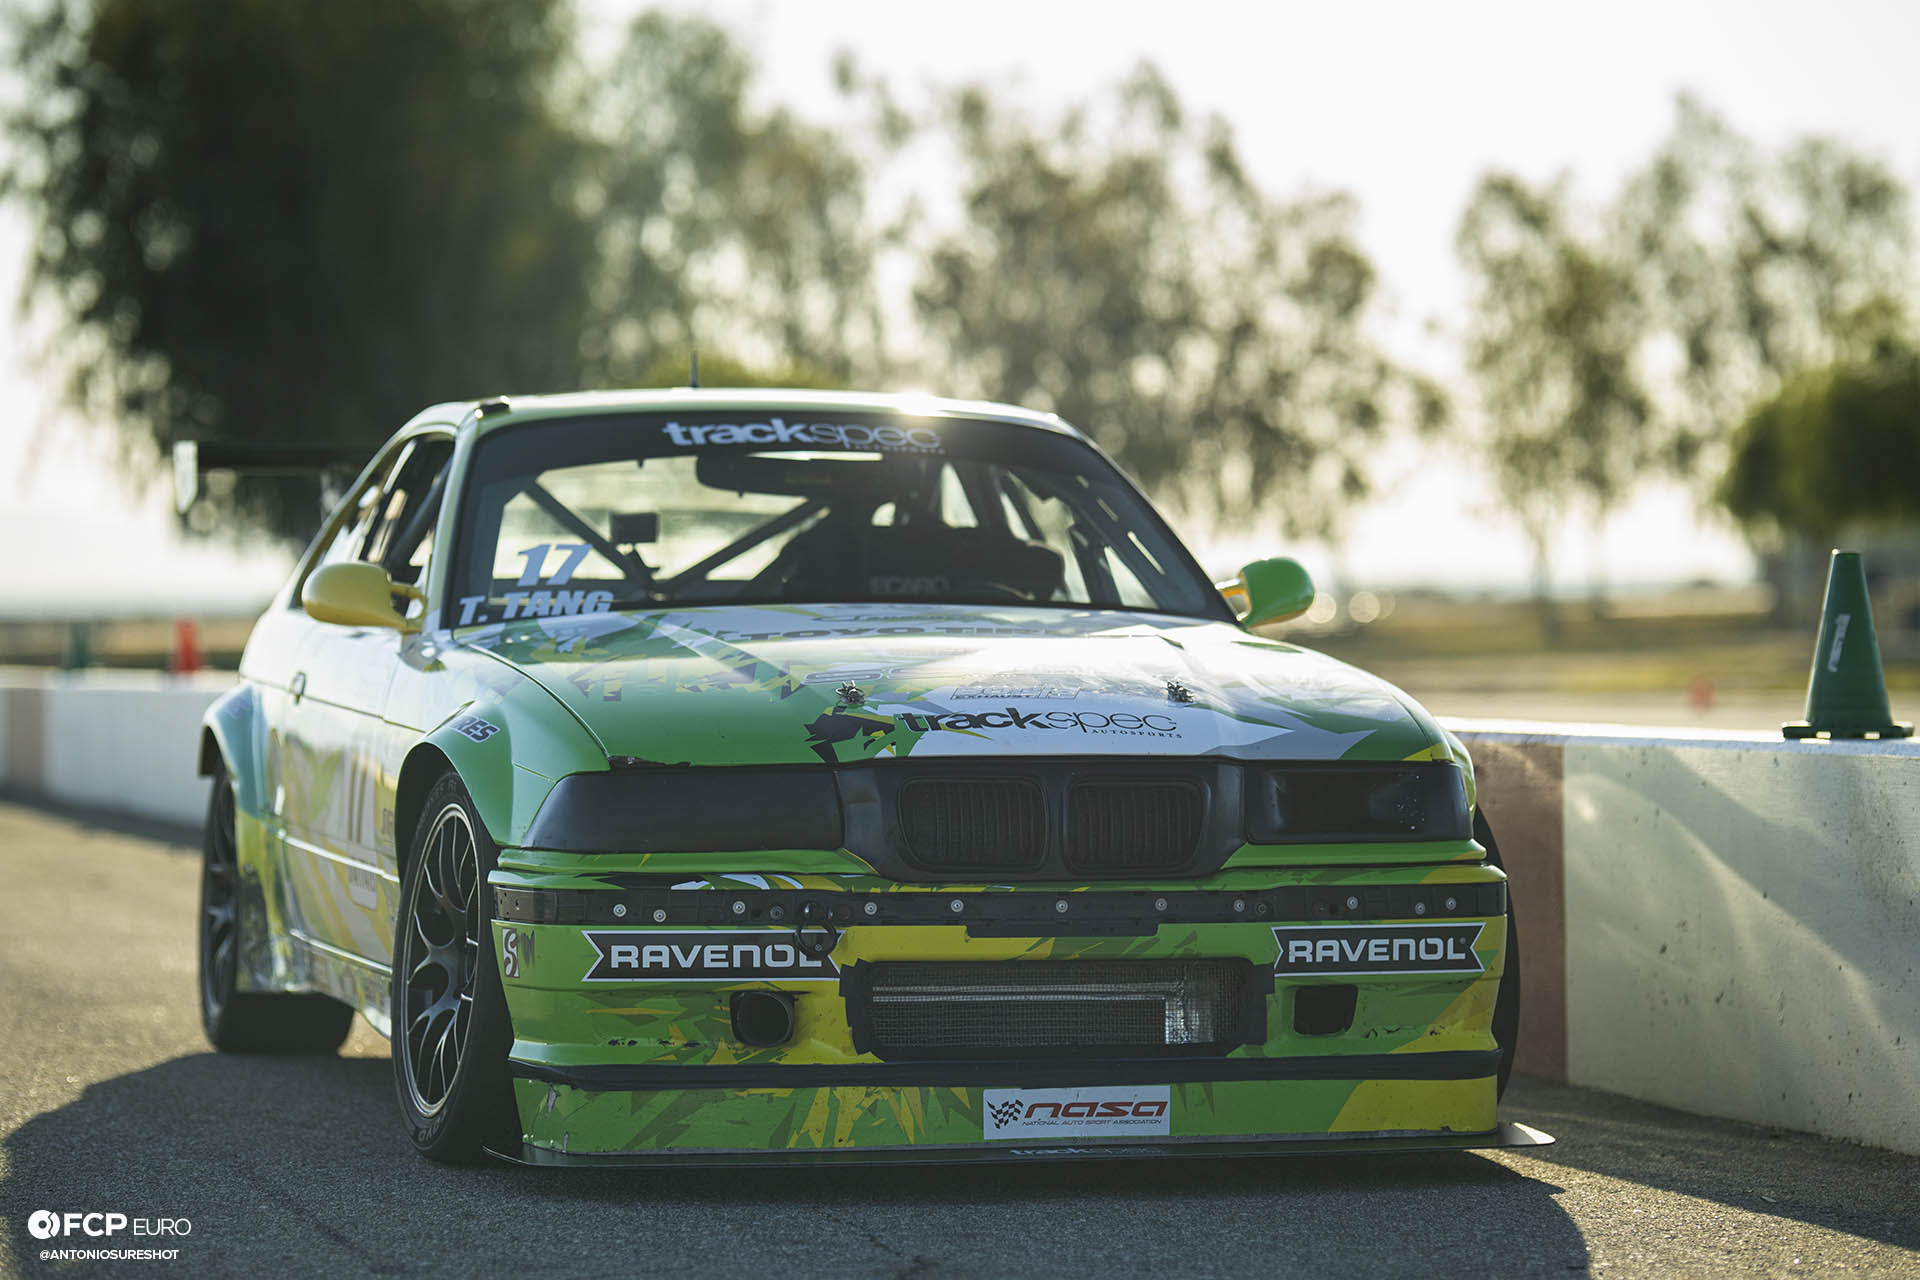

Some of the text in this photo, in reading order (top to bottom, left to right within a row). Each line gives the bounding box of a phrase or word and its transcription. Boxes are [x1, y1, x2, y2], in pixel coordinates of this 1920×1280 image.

[662, 418, 940, 449] trackspec
[517, 543, 593, 587] 17
[459, 590, 614, 625] T. TANG
[899, 707, 1177, 733] trackspec
[1092, 729, 1183, 739] AUTOSPORTS
[610, 944, 822, 969] RAVENOL
